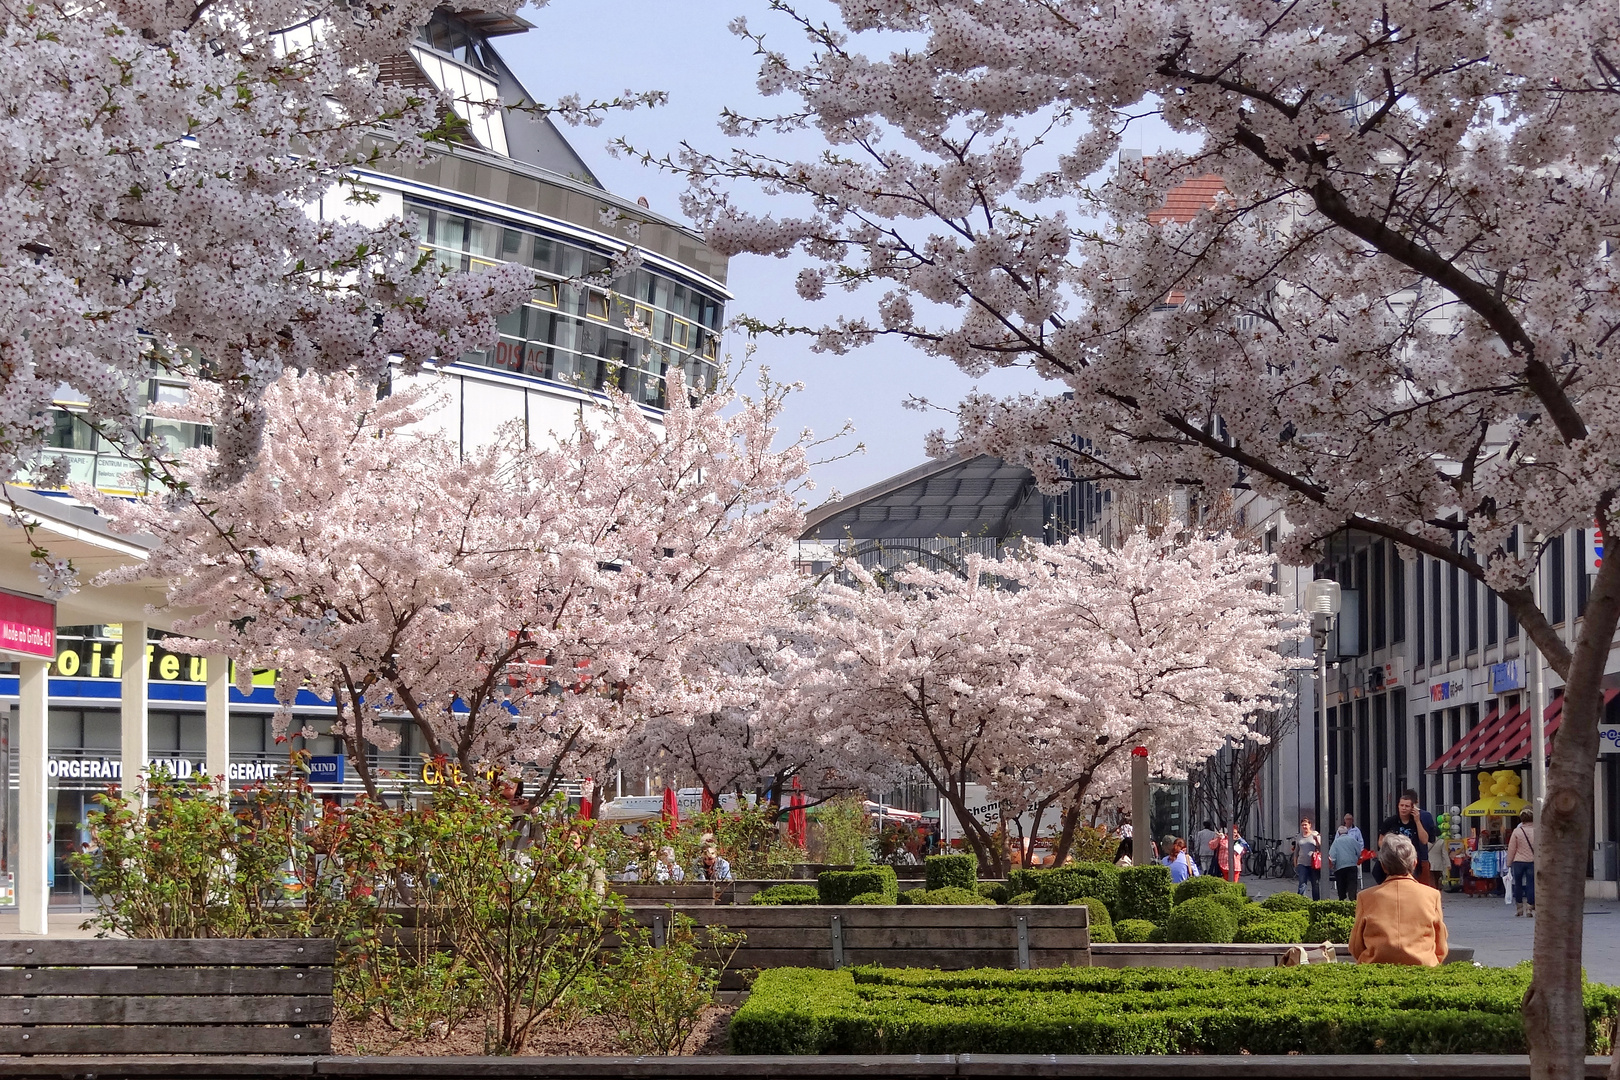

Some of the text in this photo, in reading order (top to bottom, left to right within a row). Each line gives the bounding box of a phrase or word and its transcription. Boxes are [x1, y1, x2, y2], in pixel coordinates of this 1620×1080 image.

[496, 341, 544, 374] DIS AG
[3, 623, 51, 648] Mode ab Größe 42
[48, 756, 122, 778] ÖRGERÄT
[311, 762, 336, 772] KIND
